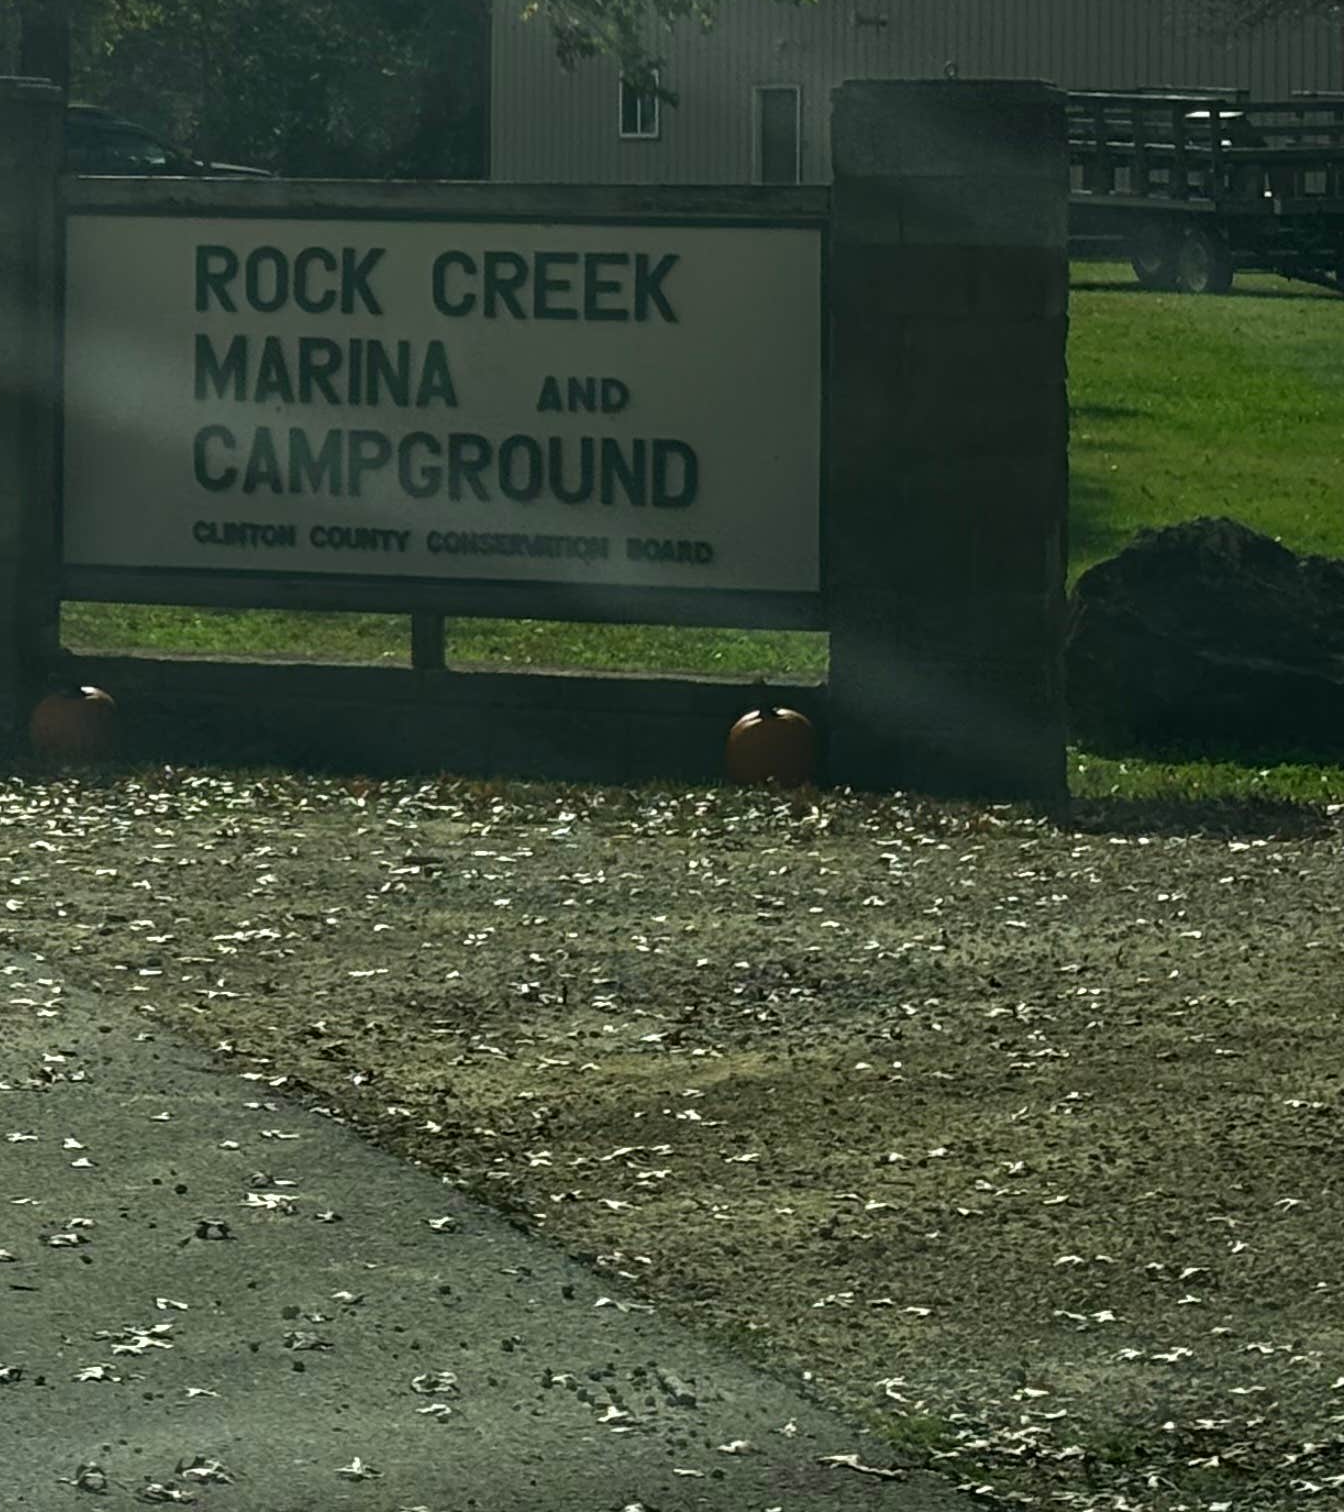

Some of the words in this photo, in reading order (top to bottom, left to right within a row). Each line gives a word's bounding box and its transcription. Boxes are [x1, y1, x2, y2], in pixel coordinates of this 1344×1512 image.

[194, 244, 386, 316] ROCK
[431, 250, 682, 324] CREEK
[194, 334, 459, 409] MARINA
[536, 374, 631, 415] AND
[192, 424, 701, 509] CAMPGROUND
[192, 520, 297, 549] CLINTON
[310, 523, 411, 554] COUNTY
[426, 529, 610, 562] CONSERVATION
[625, 536, 714, 567] BOARD
